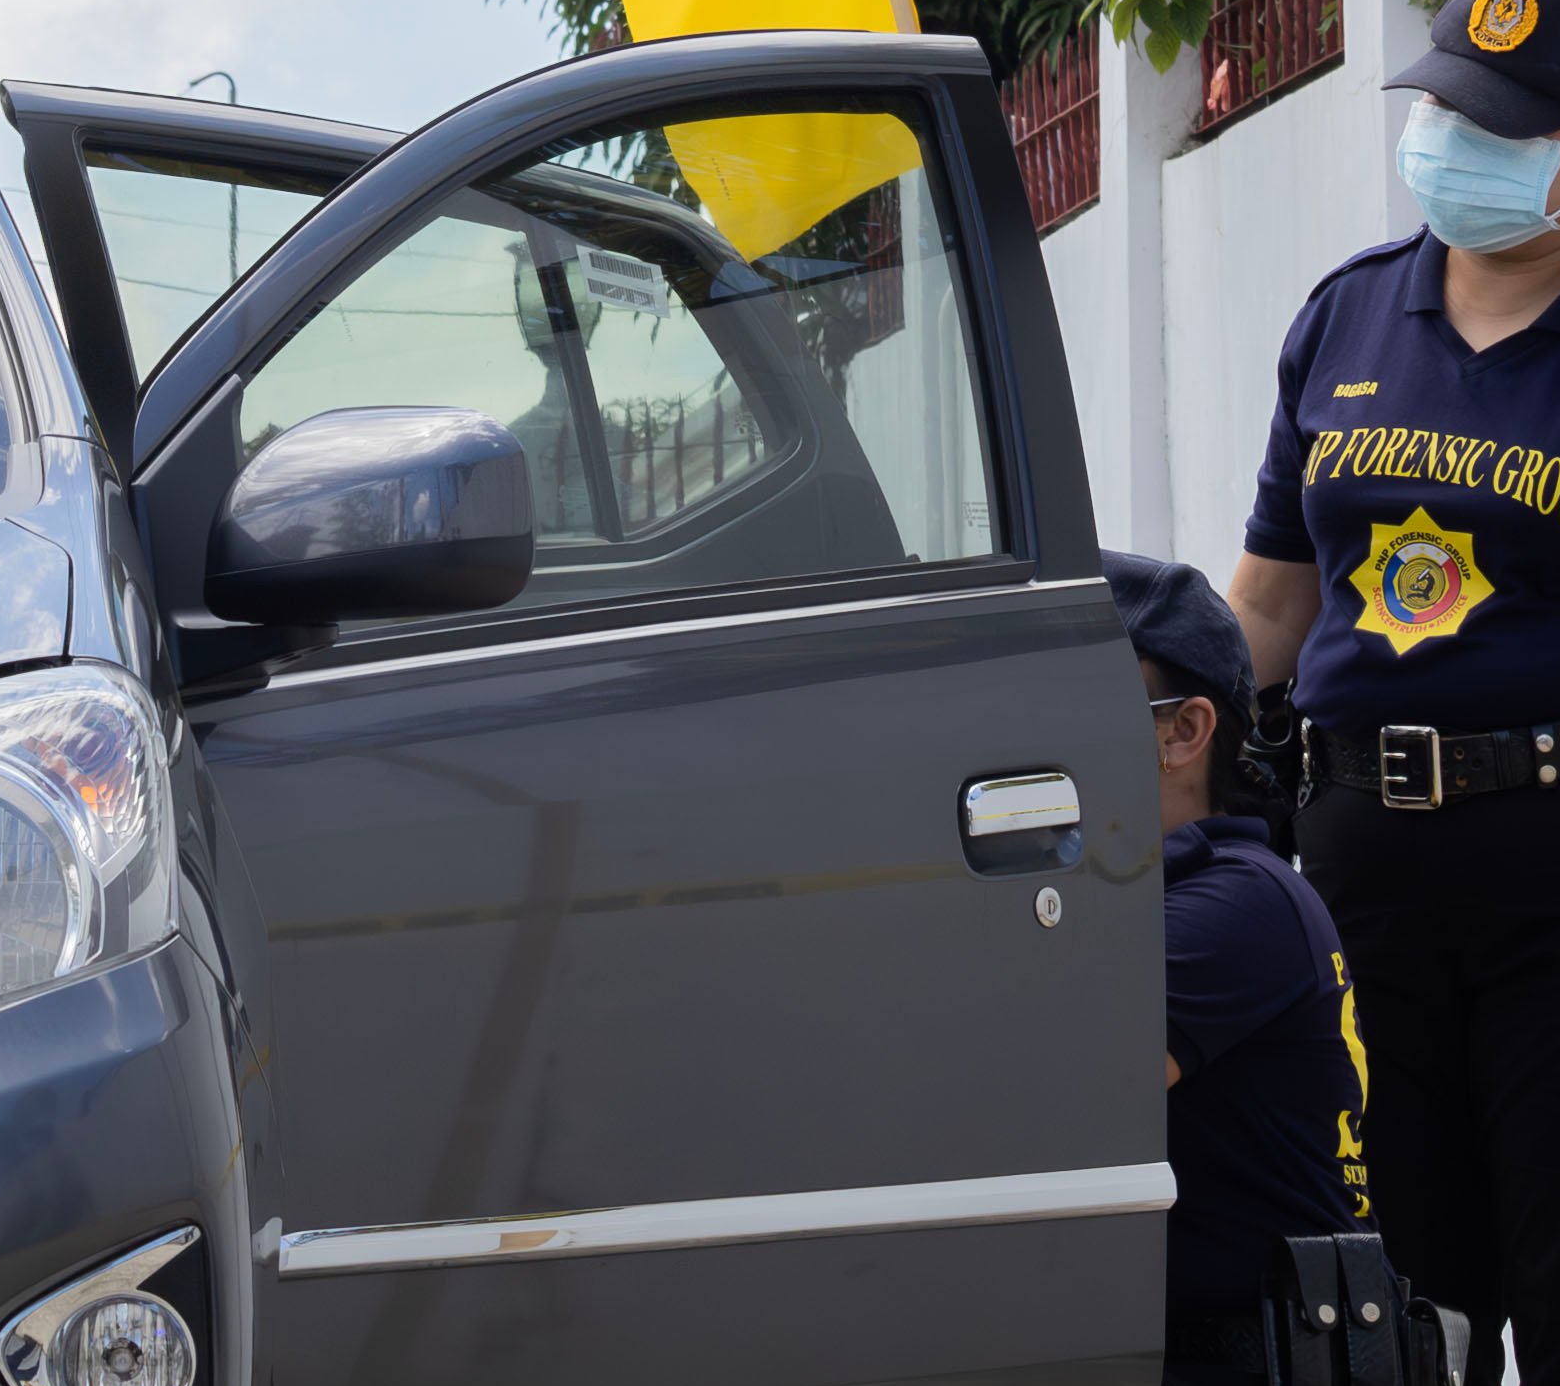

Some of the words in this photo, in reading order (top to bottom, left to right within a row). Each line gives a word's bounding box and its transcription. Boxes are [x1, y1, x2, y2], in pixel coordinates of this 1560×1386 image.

[1333, 381, 1378, 397] RAGASA
[1330, 427, 1497, 487] FORENSIC
[1375, 549, 1389, 572] PNP
[1389, 532, 1443, 551] FORENSIC
[1445, 543, 1471, 581] GROUP
[1394, 622, 1427, 633] TRUTH
[1436, 594, 1468, 627] JUSTICE
